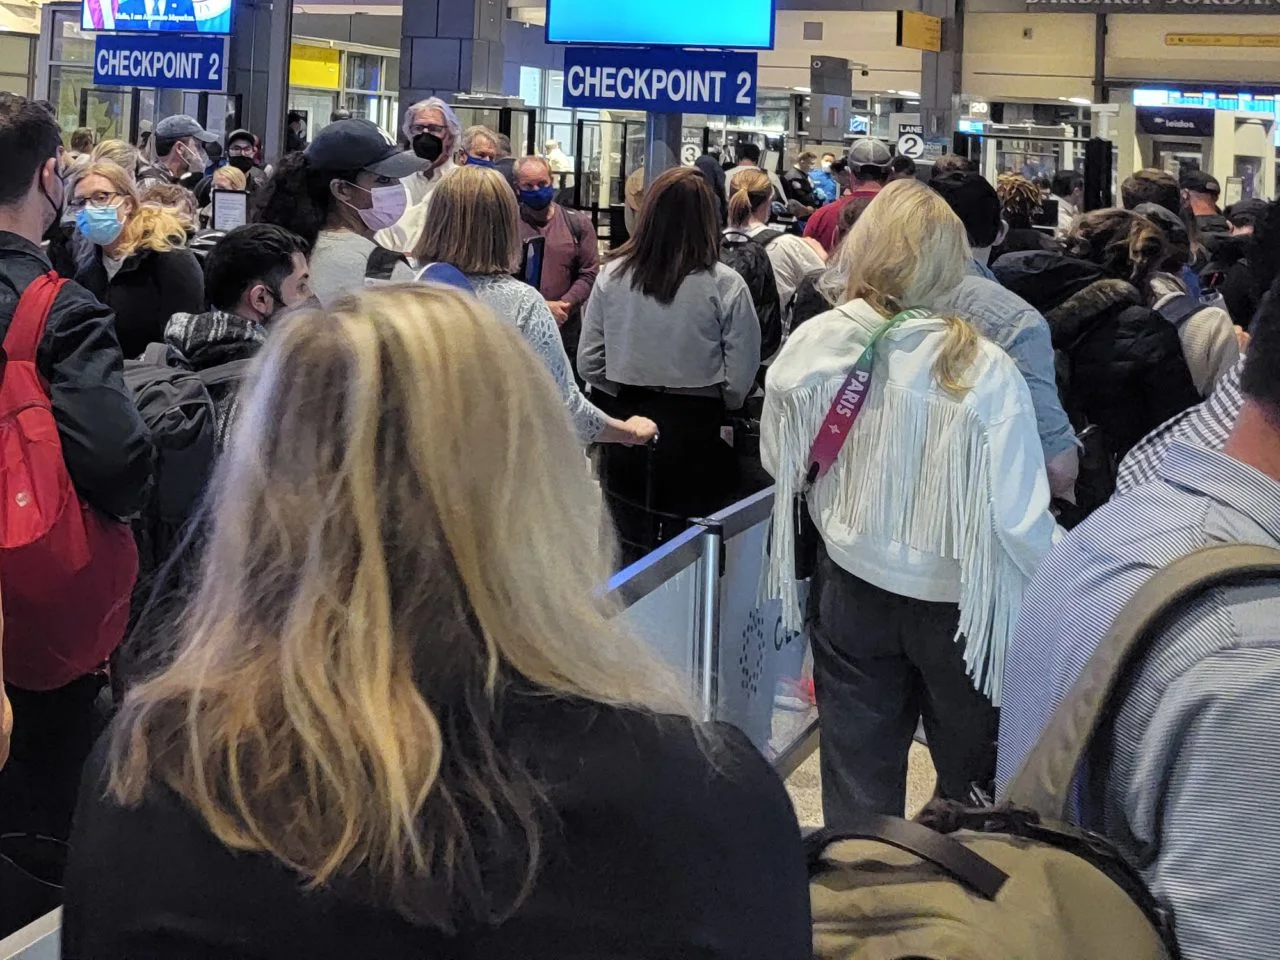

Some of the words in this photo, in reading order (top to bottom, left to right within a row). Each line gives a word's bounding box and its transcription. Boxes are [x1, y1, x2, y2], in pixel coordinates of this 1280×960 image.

[96, 48, 203, 80] CHECKPOINT
[208, 52, 220, 81] 2
[567, 65, 727, 104] CHECKPOINT
[735, 71, 752, 104] 2
[972, 102, 988, 113] 20
[900, 125, 923, 133] LANE
[684, 146, 696, 162] 3
[903, 137, 918, 156] 2
[835, 370, 869, 419] PARIS
